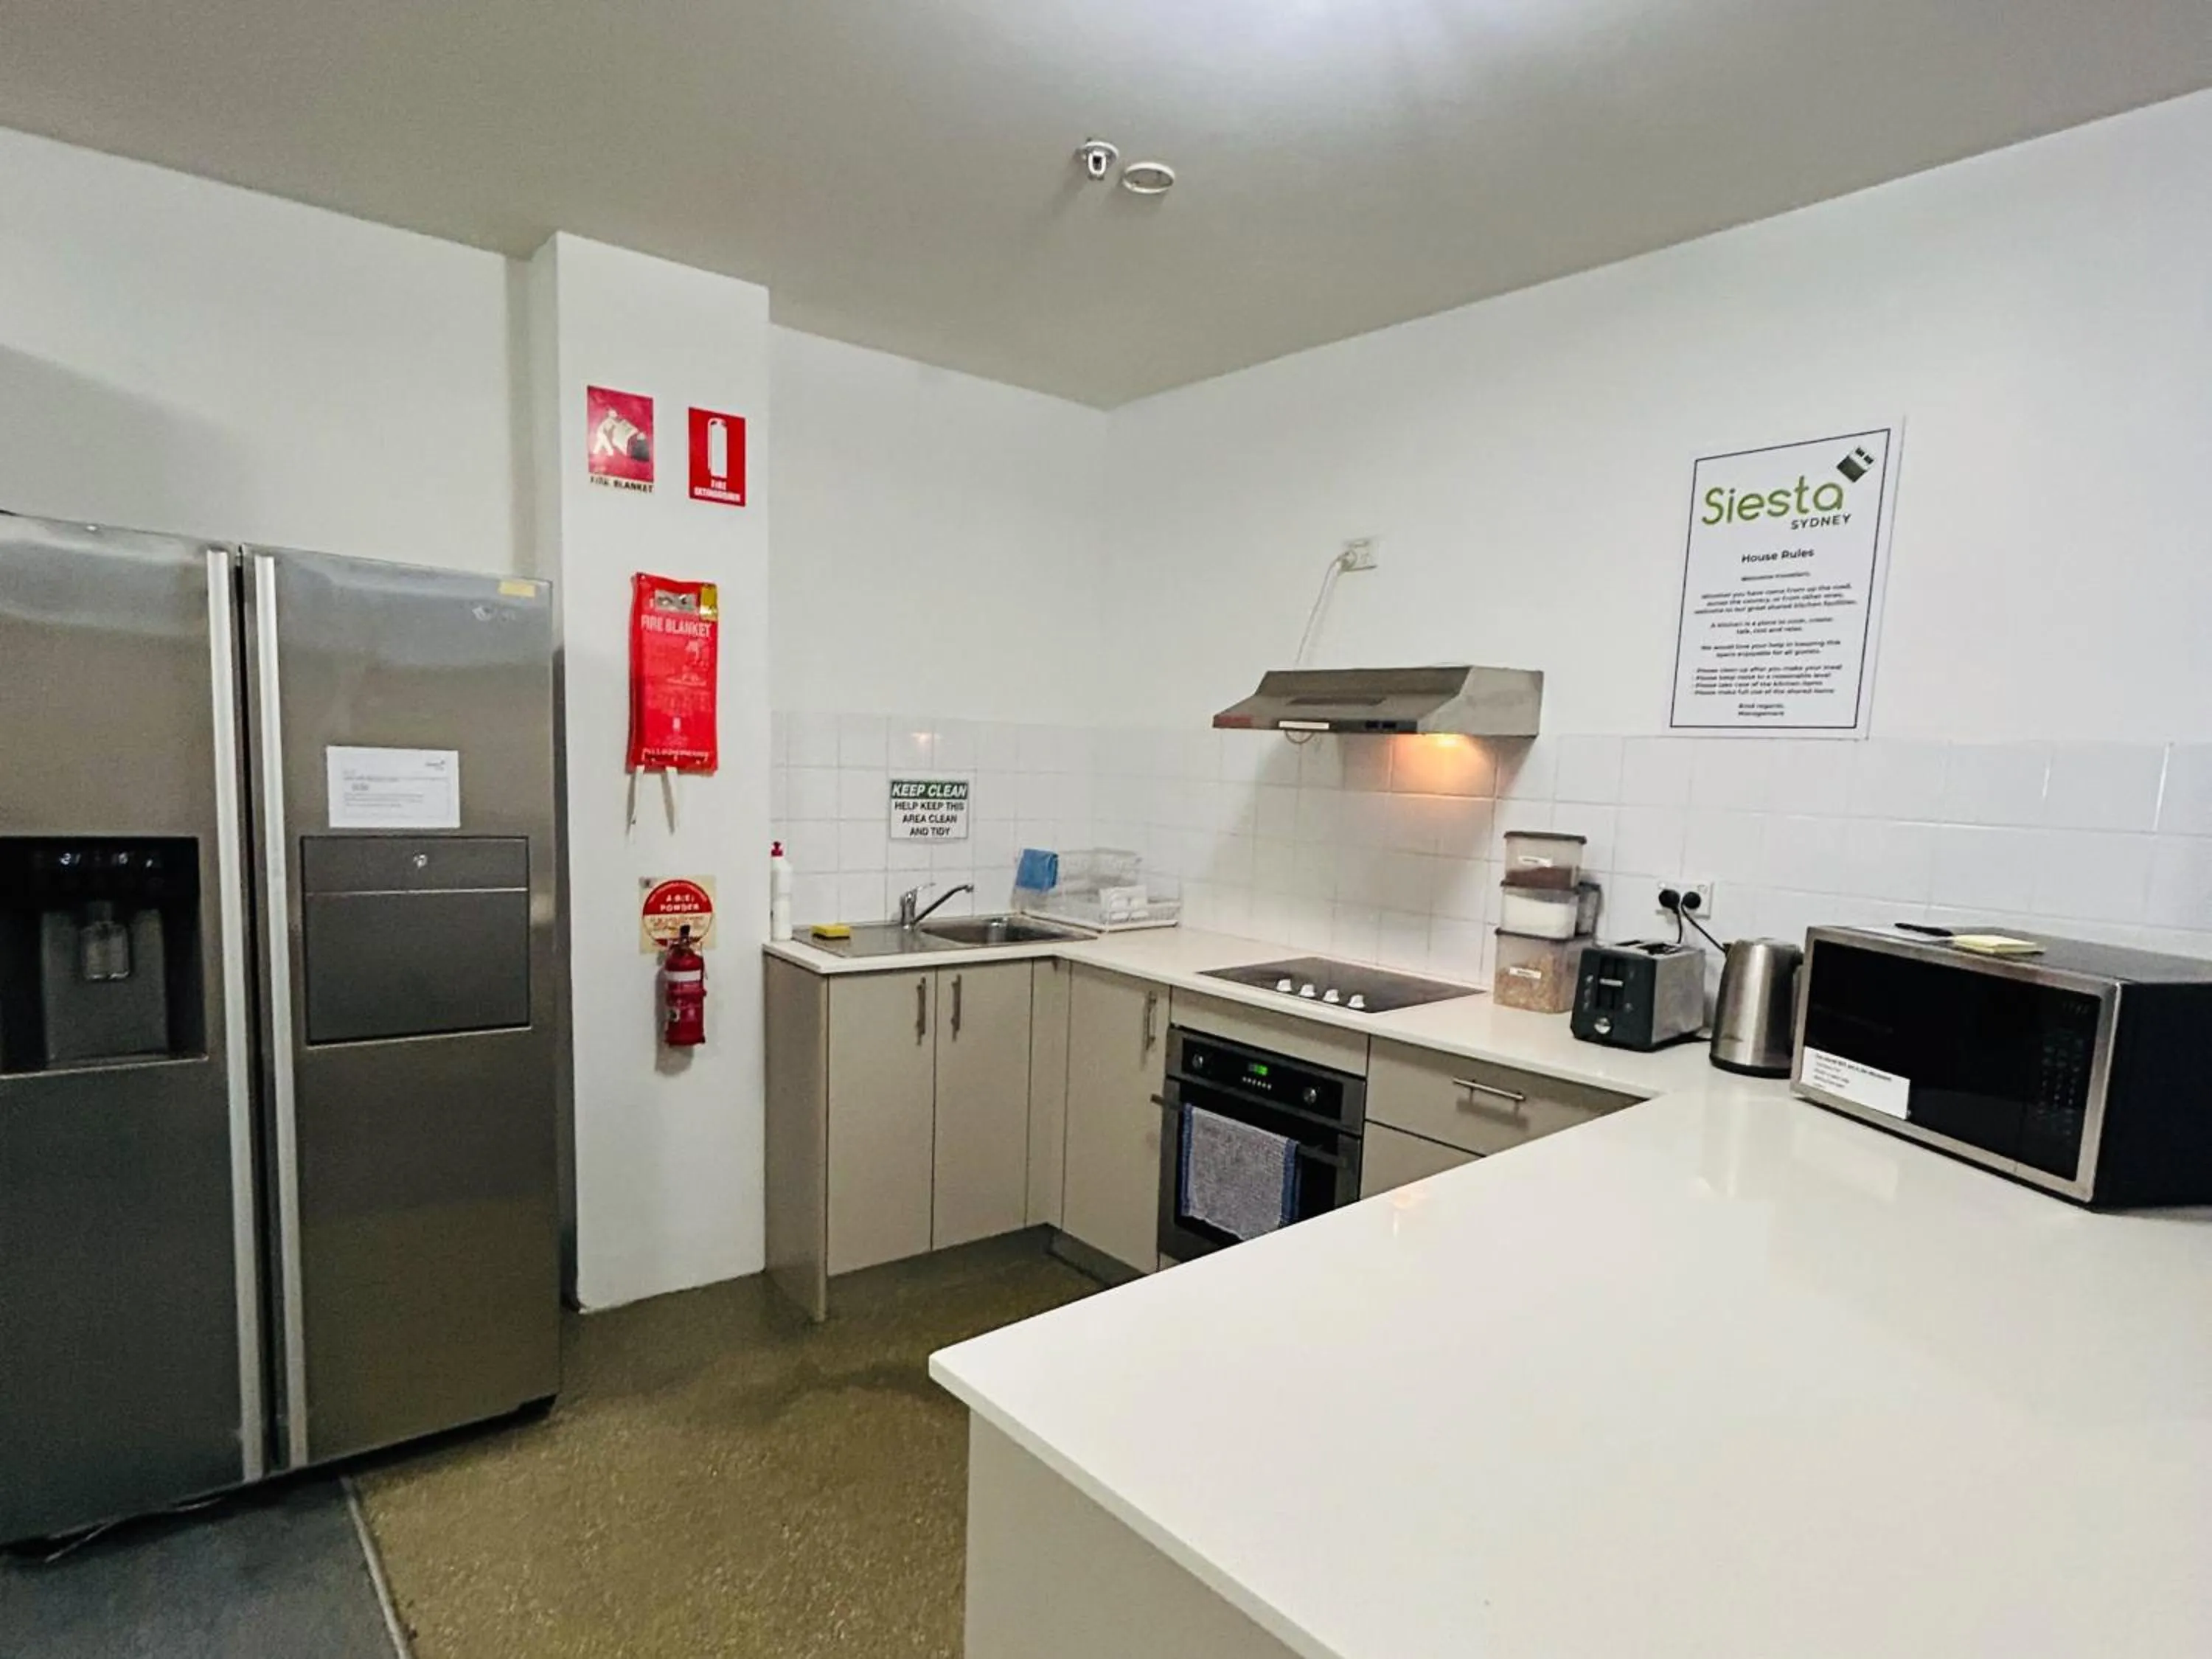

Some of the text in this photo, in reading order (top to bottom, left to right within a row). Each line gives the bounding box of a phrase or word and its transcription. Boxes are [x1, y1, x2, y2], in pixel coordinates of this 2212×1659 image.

[1702, 475, 1843, 525] Siesta
[1790, 513, 1852, 530] SYDNEY
[1741, 549, 1815, 563] House Rules
[641, 613, 712, 638] FIRE BLANKET
[891, 783, 967, 797] KEEP CLEAN
[894, 801, 964, 810] HELP KEEP THIS
[902, 813, 958, 824] AREA CLEAN
[909, 826, 950, 836] AND TIDY
[660, 903, 700, 912] POWDER
